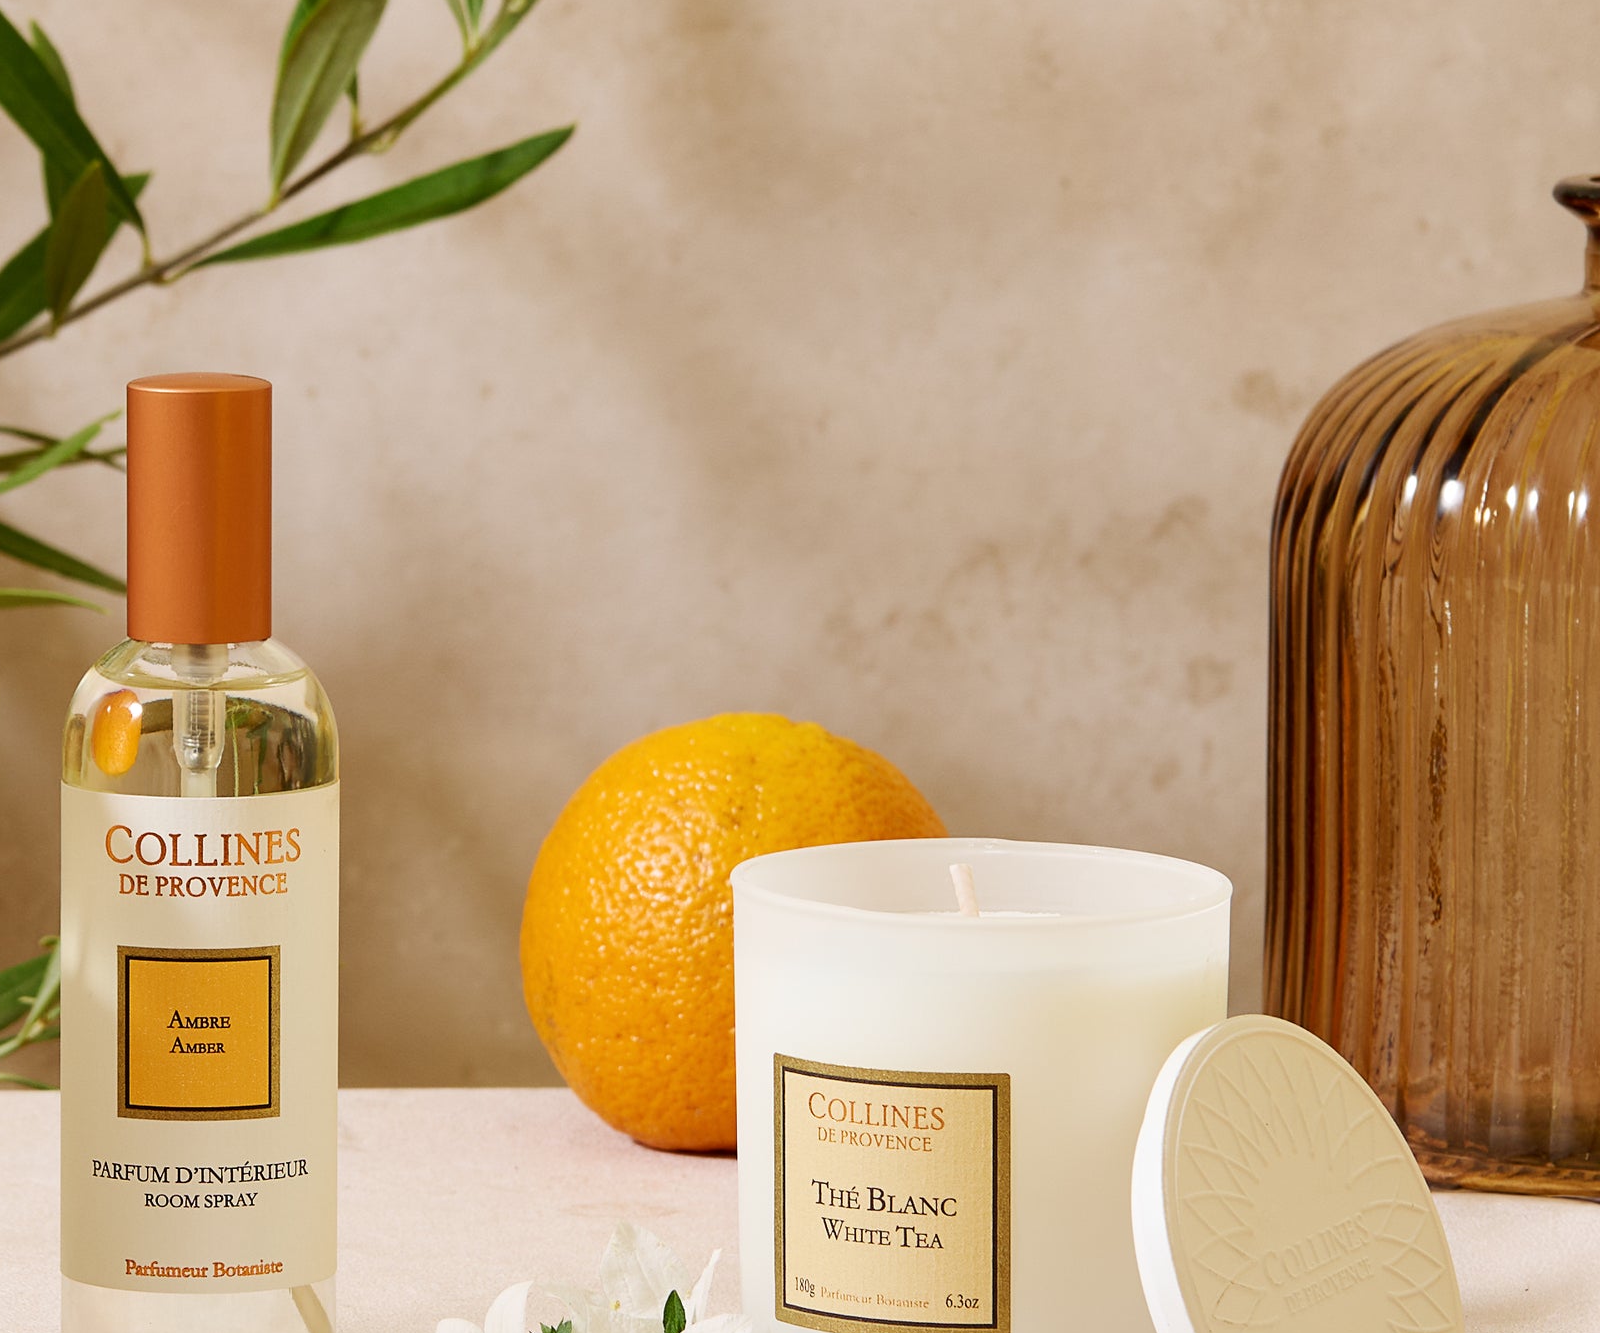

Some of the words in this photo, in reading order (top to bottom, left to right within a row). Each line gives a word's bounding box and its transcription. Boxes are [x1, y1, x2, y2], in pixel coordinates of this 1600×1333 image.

[105, 824, 301, 867] COLLINES
[119, 873, 149, 896] DE
[155, 872, 288, 897] PROVENCE
[167, 1009, 231, 1029] AMBRE
[169, 1036, 226, 1054] AMBER
[808, 1091, 946, 1131] COLLINES
[817, 1126, 836, 1144] DE
[840, 1129, 933, 1153] PROVENCE
[91, 1159, 170, 1184] PARFUM
[144, 1193, 200, 1208] ROOM
[204, 1192, 258, 1208] SPRAY
[811, 1178, 861, 1210] THÉ
[867, 1186, 957, 1217] BLANC
[821, 1216, 891, 1247] WHITE
[895, 1224, 944, 1249] TEA
[125, 1258, 208, 1278] Parfumeur
[212, 1259, 283, 1278] Botaniste
[795, 1276, 815, 1298] 180g
[945, 1293, 979, 1309] 6.3oz
